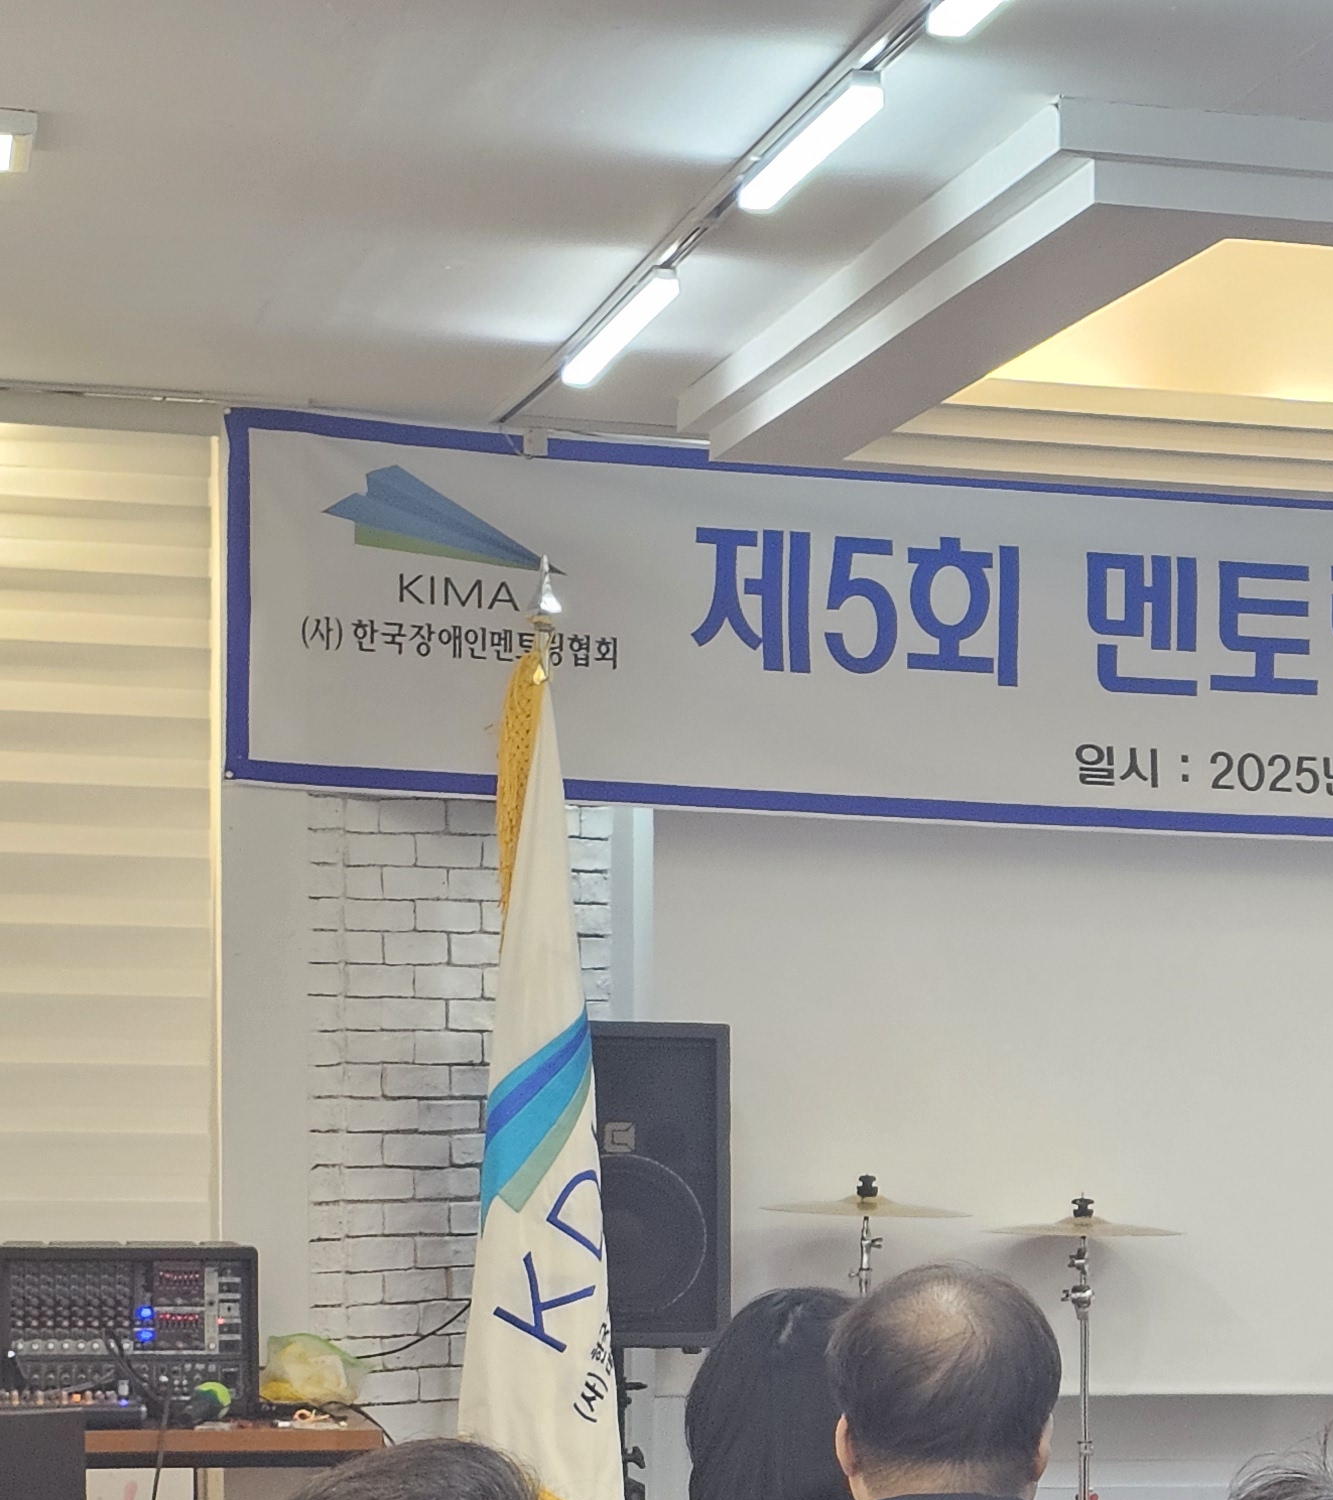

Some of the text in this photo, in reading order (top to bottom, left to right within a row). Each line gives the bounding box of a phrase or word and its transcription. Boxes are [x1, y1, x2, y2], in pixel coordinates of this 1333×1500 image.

[398, 573, 520, 612] KIMA
[691, 526, 1020, 687] 제5회
[301, 616, 343, 651] (사)
[1075, 743, 1159, 788] 일시
[1179, 754, 1191, 784] :
